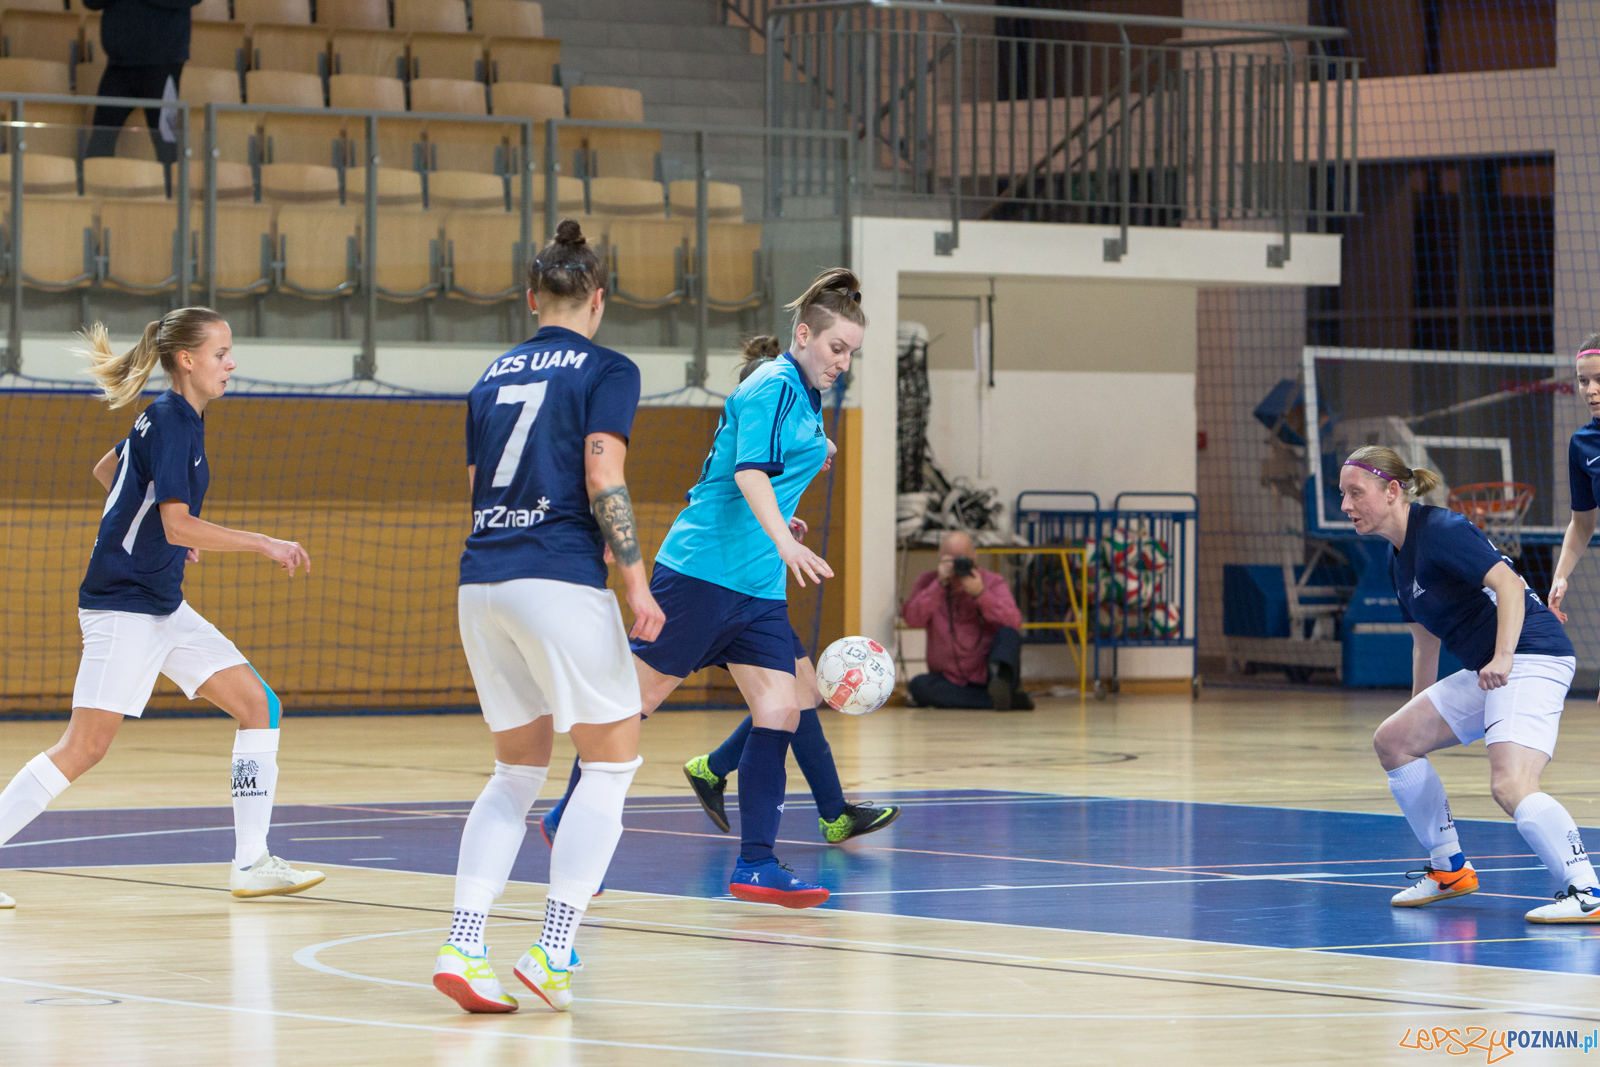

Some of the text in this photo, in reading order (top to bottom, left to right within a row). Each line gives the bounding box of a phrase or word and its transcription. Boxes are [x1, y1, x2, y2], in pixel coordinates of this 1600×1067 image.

[483, 349, 588, 382] AZS UAM
[491, 379, 548, 488] 7
[590, 440, 604, 455] 15
